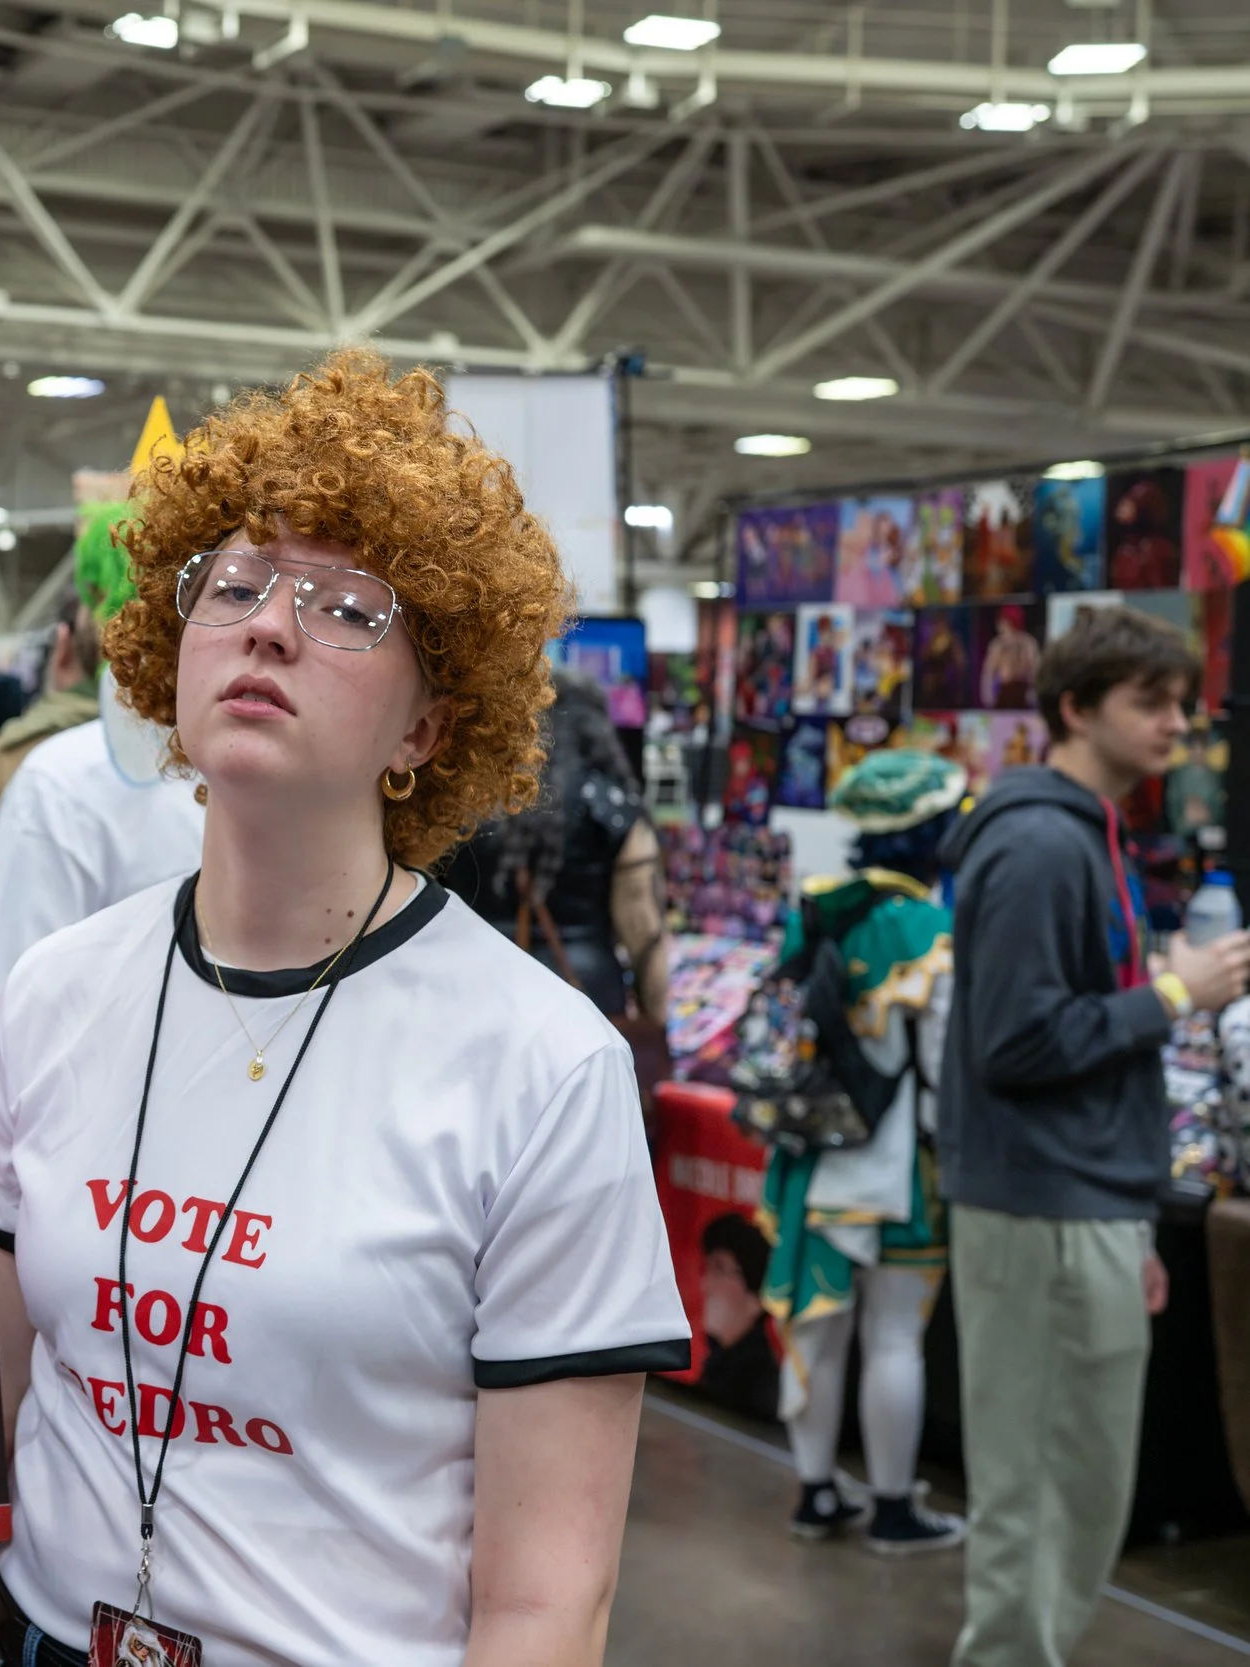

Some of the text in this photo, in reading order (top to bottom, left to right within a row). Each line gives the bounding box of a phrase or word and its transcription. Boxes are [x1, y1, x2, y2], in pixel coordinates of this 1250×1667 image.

[86, 1179, 272, 1269] VOTE
[91, 1277, 232, 1364] FOR
[61, 1362, 293, 1455] EDRO
